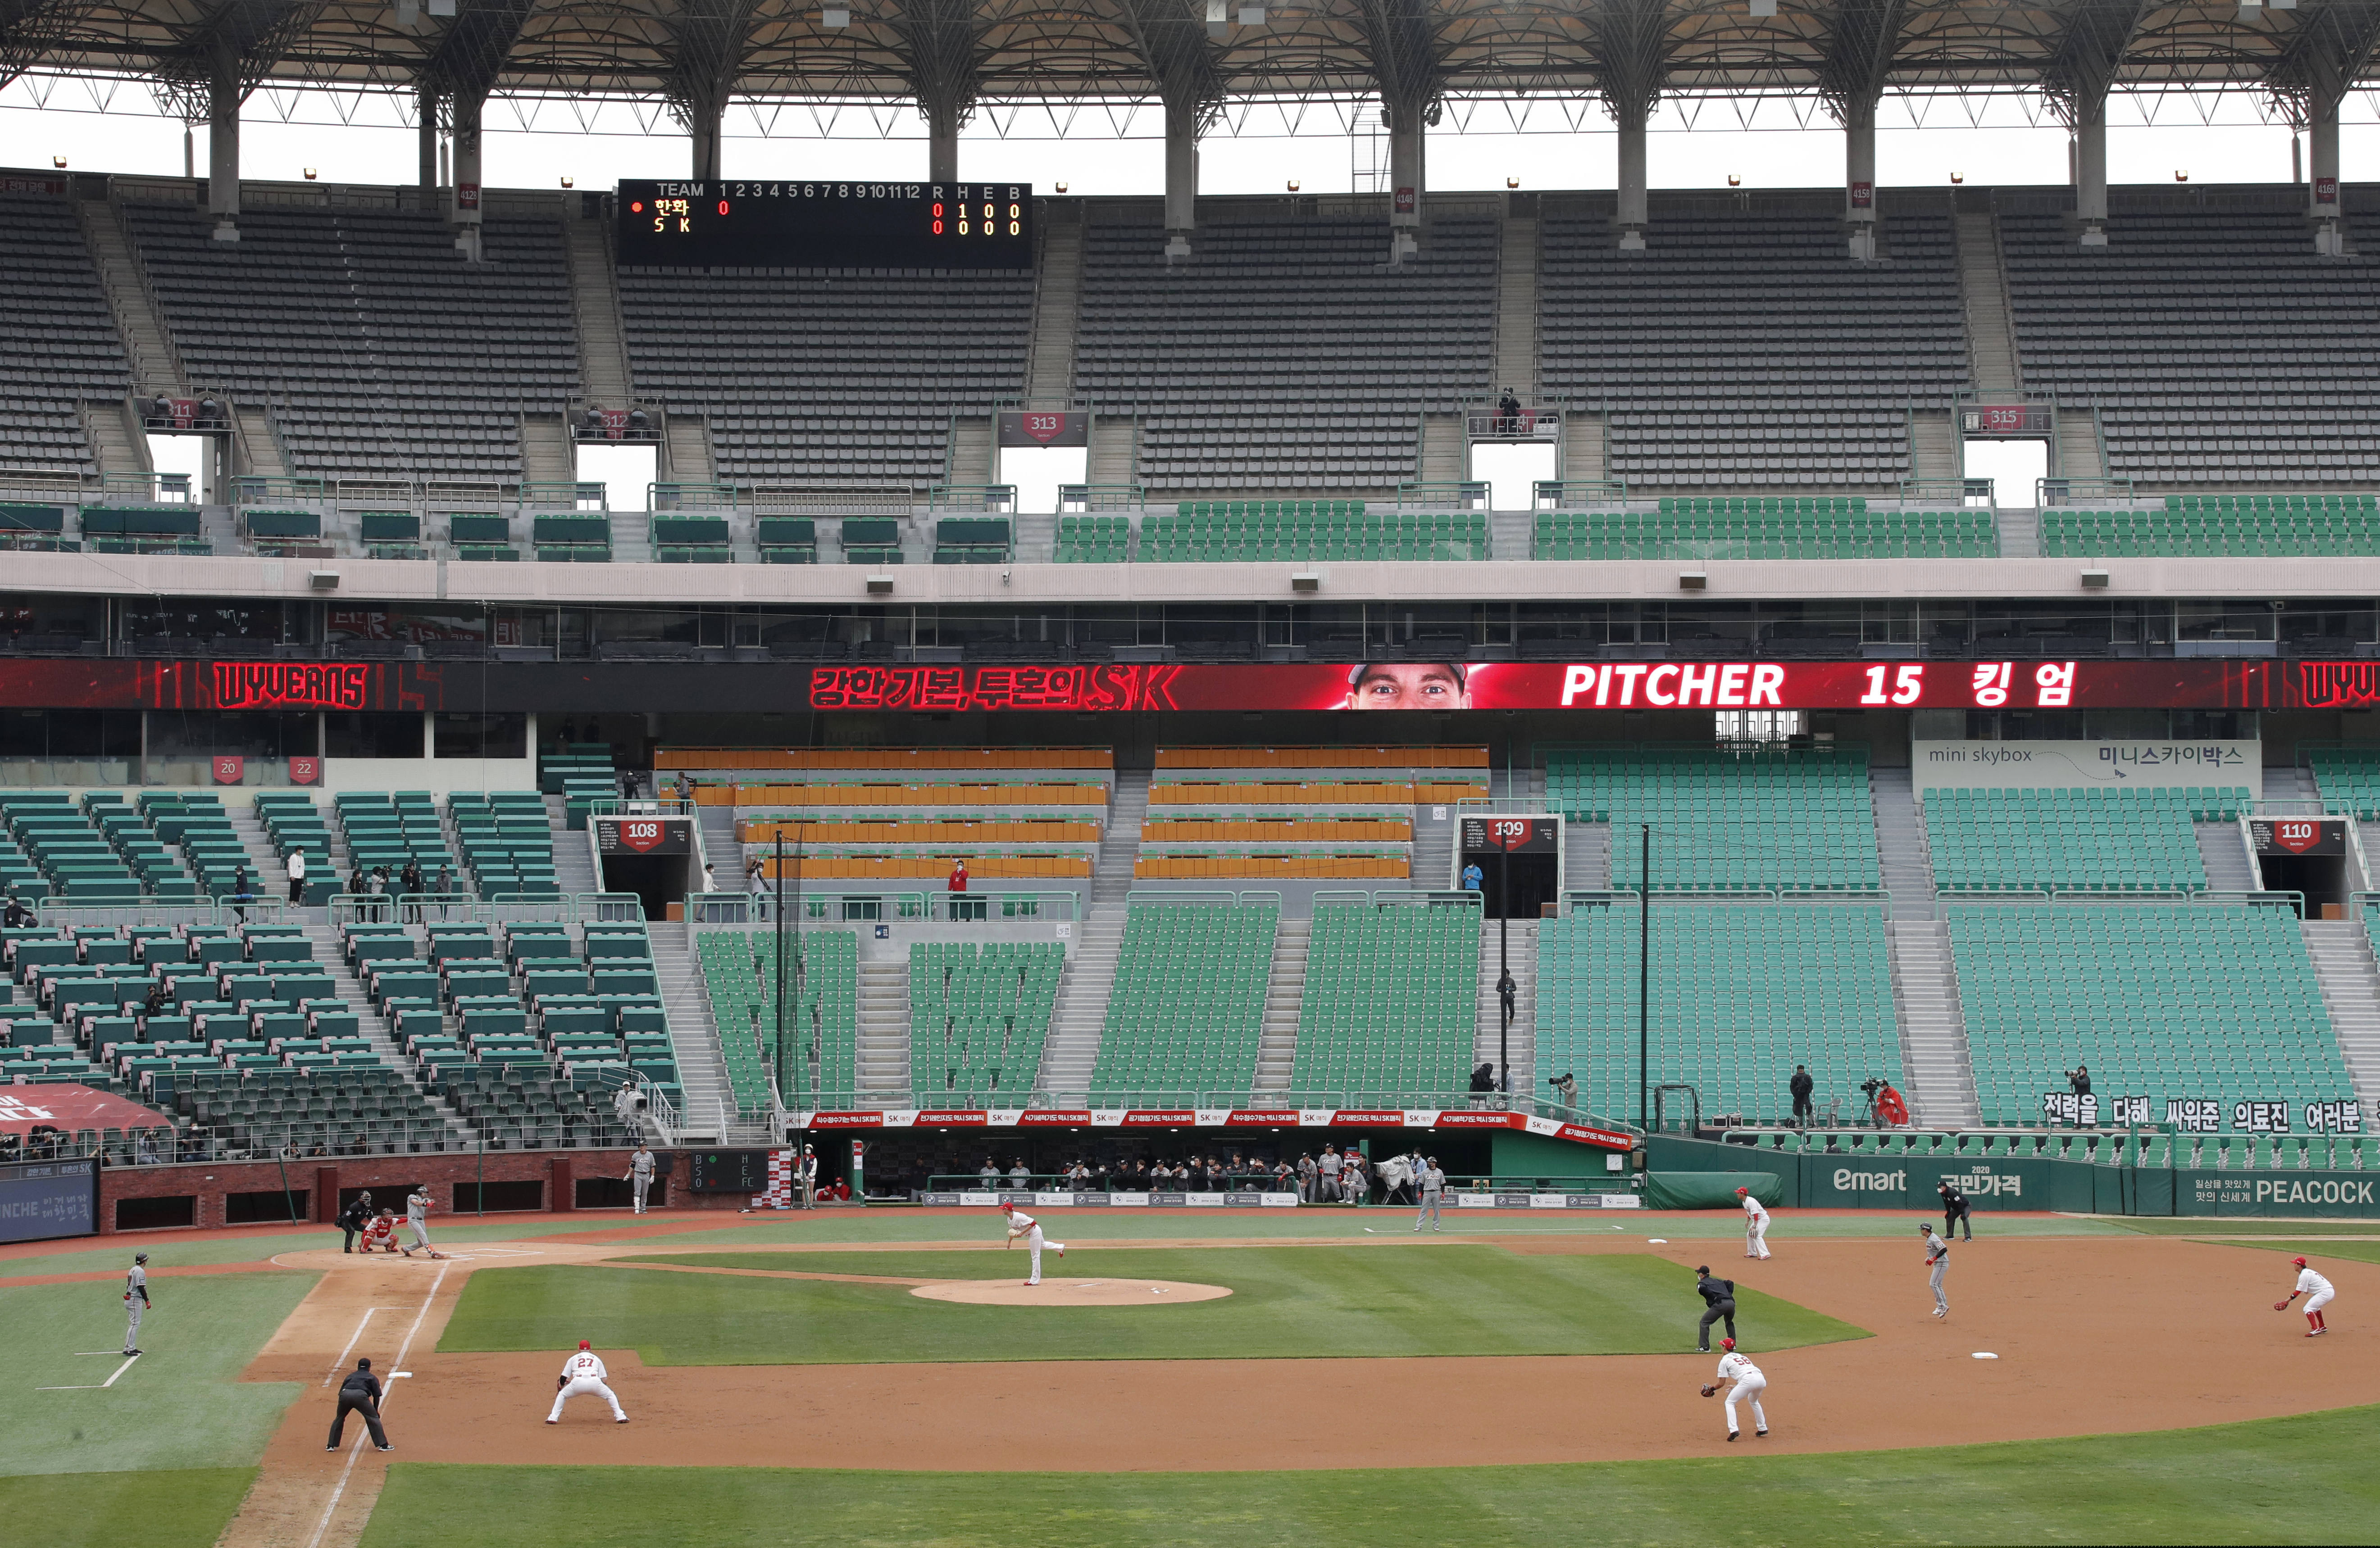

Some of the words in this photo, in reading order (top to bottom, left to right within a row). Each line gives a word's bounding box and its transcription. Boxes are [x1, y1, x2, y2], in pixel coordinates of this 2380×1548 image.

[657, 183, 704, 196] TEAM
[720, 184, 725, 196] 1
[736, 184, 745, 196] 2
[753, 184, 762, 197] 3
[770, 184, 779, 197] 4
[788, 185, 797, 197] 5
[804, 185, 814, 197] 6
[822, 185, 831, 197] 7
[839, 185, 849, 198] 8
[856, 185, 865, 198] 9
[870, 185, 885, 198] 10
[888, 186, 901, 199] 11
[905, 186, 919, 199] 12
[933, 186, 943, 199] R
[958, 187, 968, 200] H
[985, 187, 993, 200] E
[1010, 187, 1019, 200] B
[655, 200, 689, 216] 한화
[719, 201, 728, 215] 0
[933, 204, 943, 218] 0
[959, 204, 967, 218] 1
[984, 204, 993, 218] 0
[1010, 204, 1019, 218] 0
[933, 220, 943, 234] 0
[959, 221, 968, 235] 0
[984, 221, 993, 235] 0
[1010, 221, 1019, 236] 0
[602, 414, 628, 427] 312
[1031, 417, 1056, 430] 313
[1991, 410, 2017, 423] 315
[216, 664, 367, 708] WYVERNS
[813, 670, 885, 707] 강한
[888, 670, 968, 709] 기본,
[976, 668, 1081, 707] 투혼의
[1084, 665, 1175, 711] SK
[1561, 664, 1784, 705] PITCHER
[1861, 666, 1922, 704] 15
[1973, 662, 2011, 706] 킹
[2036, 662, 2075, 705] 엄
[1929, 746, 1966, 762] mini
[1972, 746, 2032, 766] skybox
[2099, 745, 2243, 766] 미니스카이박스
[221, 763, 235, 773] 20
[297, 763, 311, 773] 22
[628, 823, 657, 837] 108
[1495, 822, 1524, 836] 109
[2282, 824, 2312, 838] 110
[2043, 1092, 2099, 1124] 전력을
[2112, 1097, 2151, 1128] 다해
[2166, 1099, 2221, 1132] 싸워준
[2234, 1100, 2289, 1133] 의료진
[2306, 1100, 2361, 1133] 여러분
[1597, 1134, 1609, 1142] 역시
[696, 1154, 701, 1164] B
[742, 1154, 748, 1163] H
[79, 1162, 92, 1173] SK
[696, 1167, 701, 1176] S
[742, 1166, 748, 1175] E
[742, 1177, 754, 1187] FC
[1834, 1169, 1906, 1190] emart
[2195, 1180, 2221, 1189] 일상을
[2225, 1180, 2250, 1189] 맛있게
[2196, 1192, 2215, 1202] 맛의
[2221, 1192, 2250, 1202] 신세계
[2257, 1180, 2374, 1203] PEACOCK
[0, 1201, 38, 1218] NCHE
[578, 1358, 594, 1368] 27
